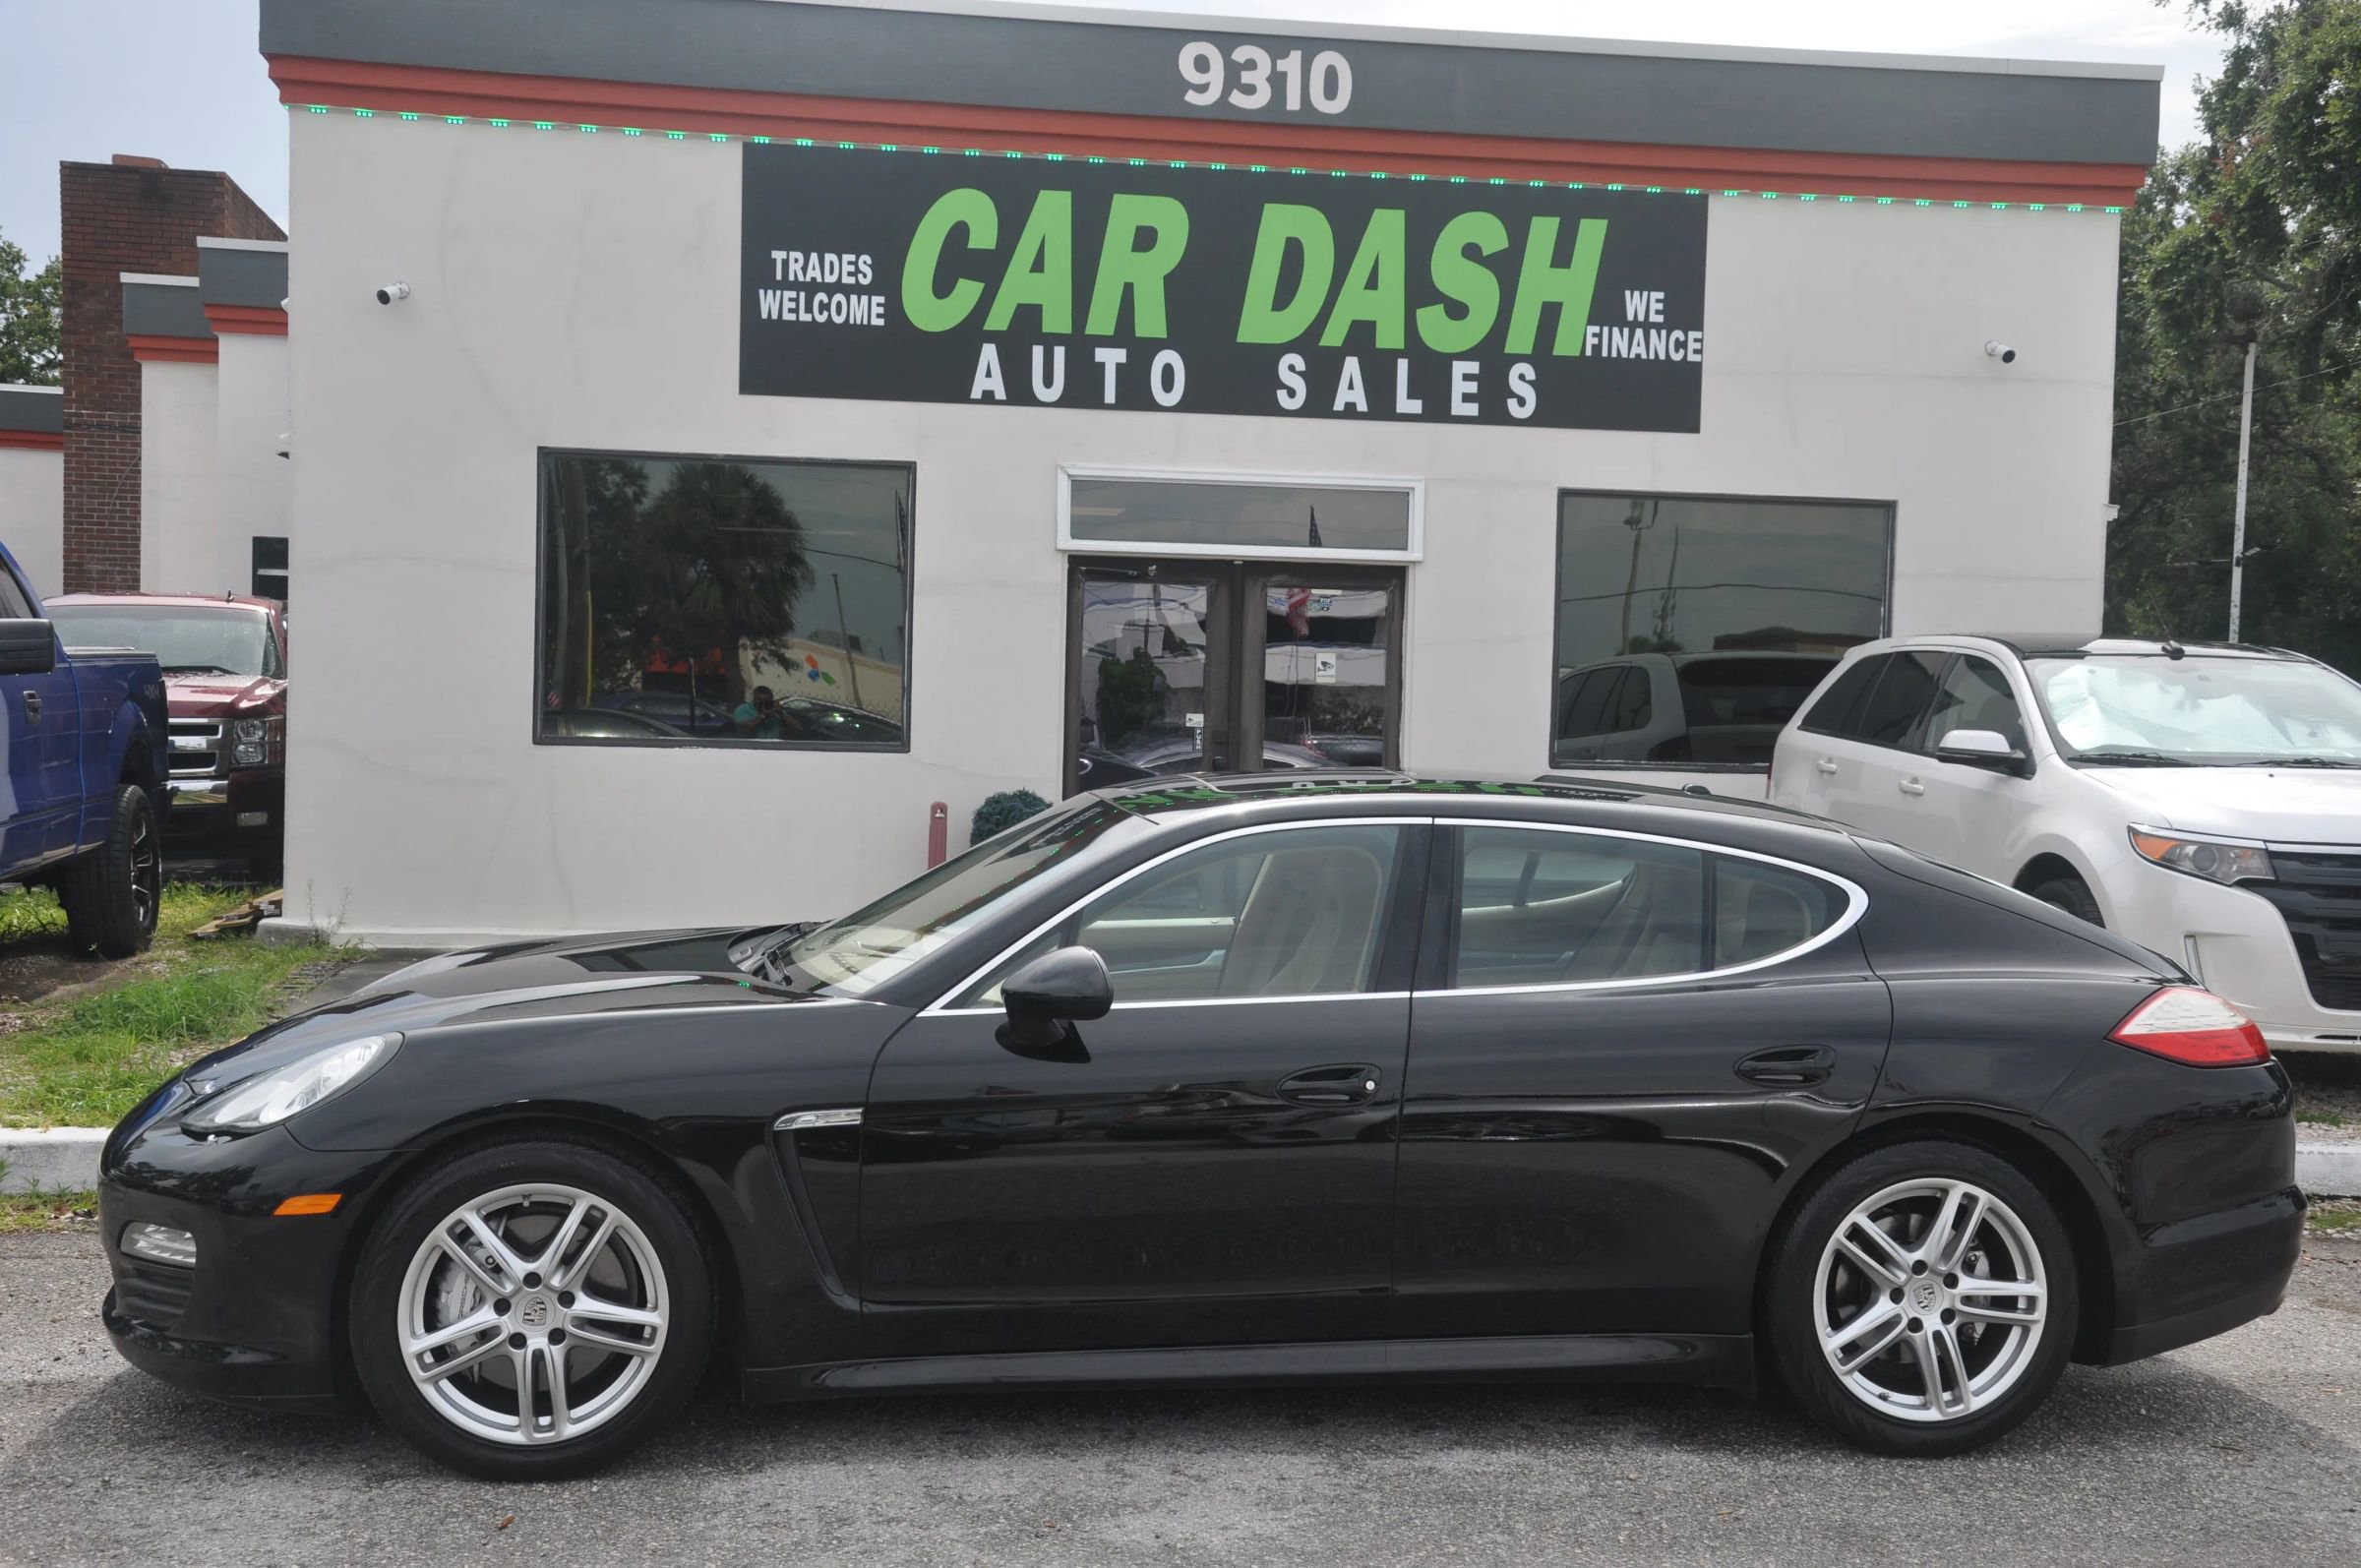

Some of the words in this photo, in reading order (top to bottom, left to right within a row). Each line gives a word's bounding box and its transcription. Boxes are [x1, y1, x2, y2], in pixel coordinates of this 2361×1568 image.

[1179, 41, 1353, 114] 9310
[771, 250, 873, 285] TRADES
[901, 188, 1189, 338] CAR
[1236, 203, 1608, 356] DASH
[758, 289, 885, 326] WELCOME
[1624, 289, 1665, 323] WE
[1585, 326, 1703, 362] FINANCE
[969, 342, 1185, 407] AUTO
[1276, 353, 1537, 419] SALES
[457, 1273, 470, 1320] ORSCHE
